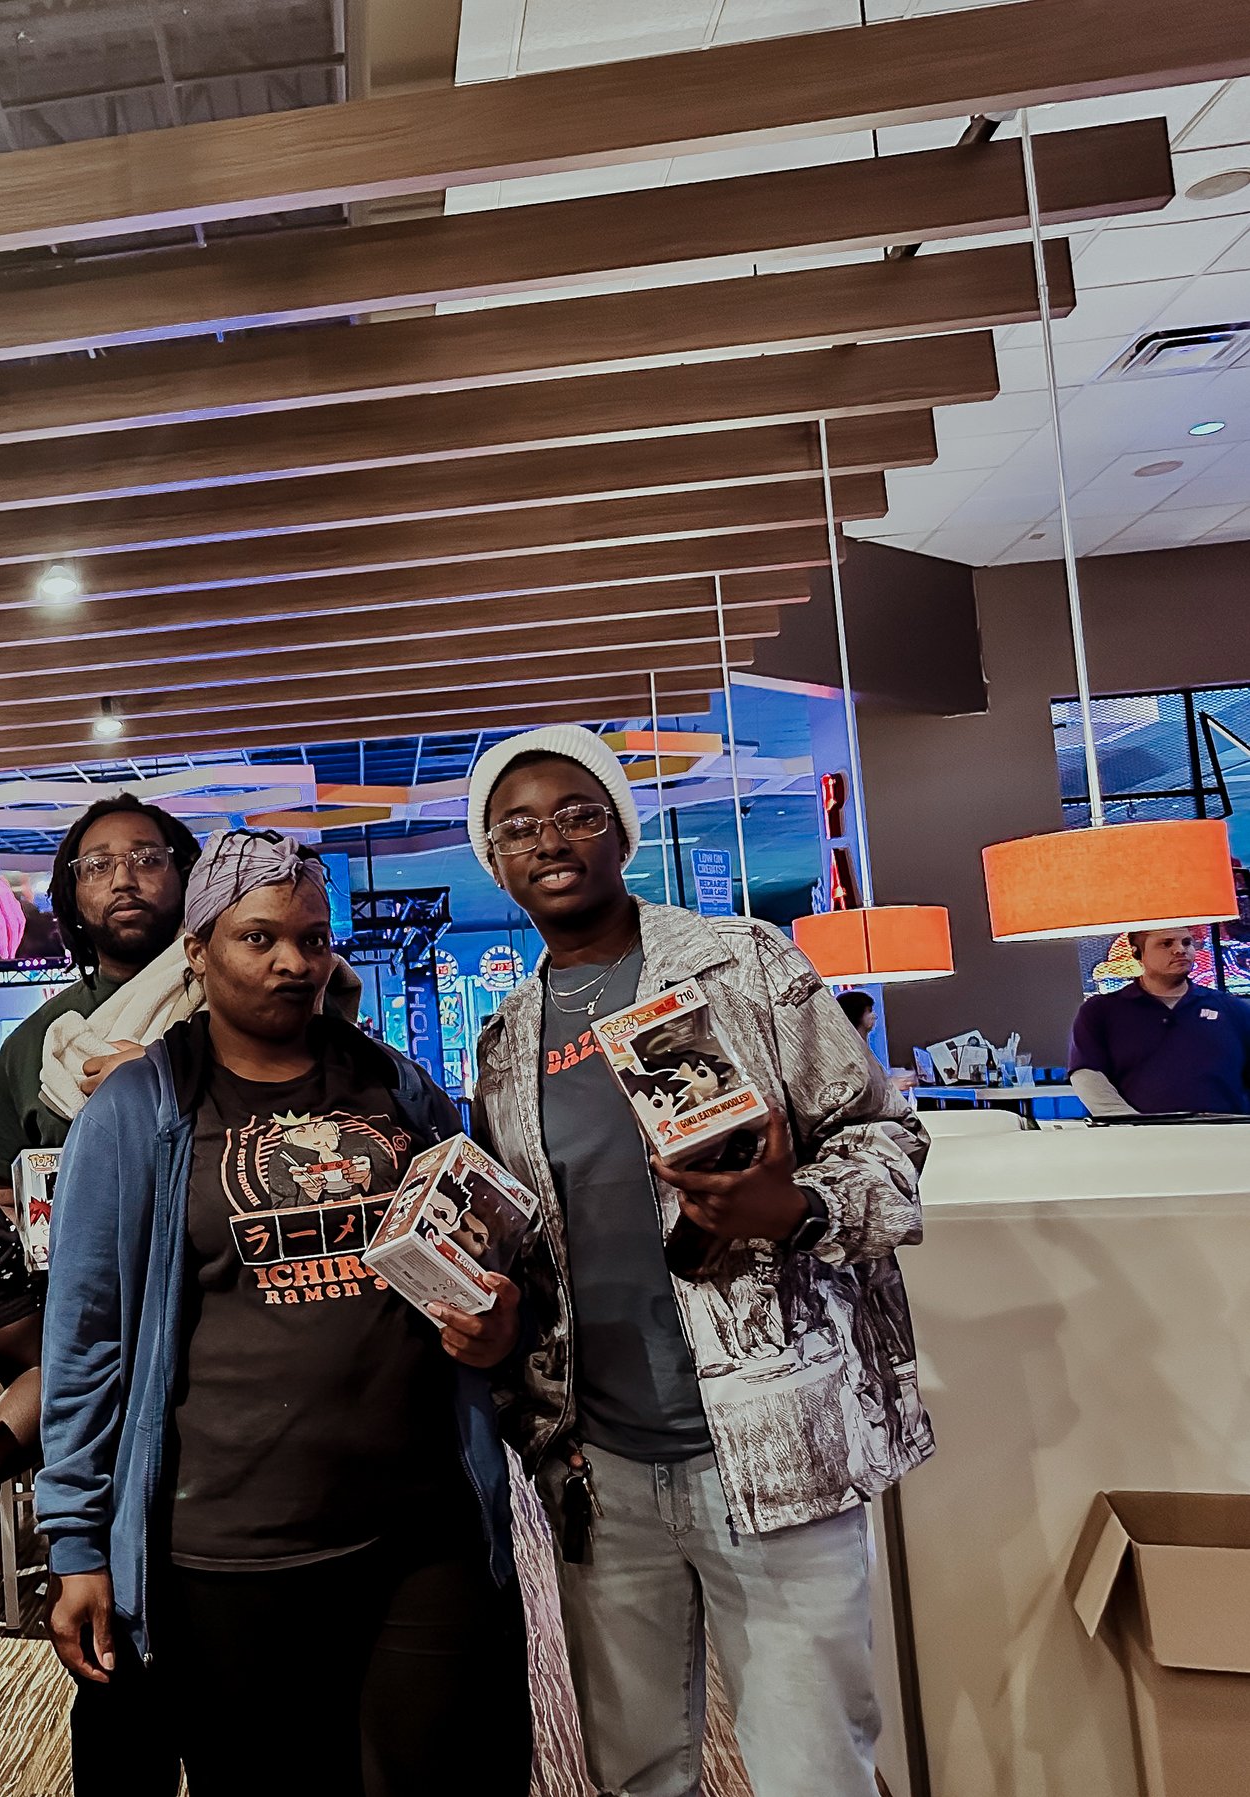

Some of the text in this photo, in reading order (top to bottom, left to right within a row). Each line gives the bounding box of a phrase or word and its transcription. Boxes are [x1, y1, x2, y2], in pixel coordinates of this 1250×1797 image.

[600, 989, 695, 1040] POP! 710
[546, 1029, 603, 1075] DAZ
[679, 1114, 697, 1129] GOKU
[28, 1153, 56, 1169] POP!
[463, 1140, 488, 1169] POP!
[518, 1192, 531, 1207] 700
[244, 1211, 384, 1256] ラーメ
